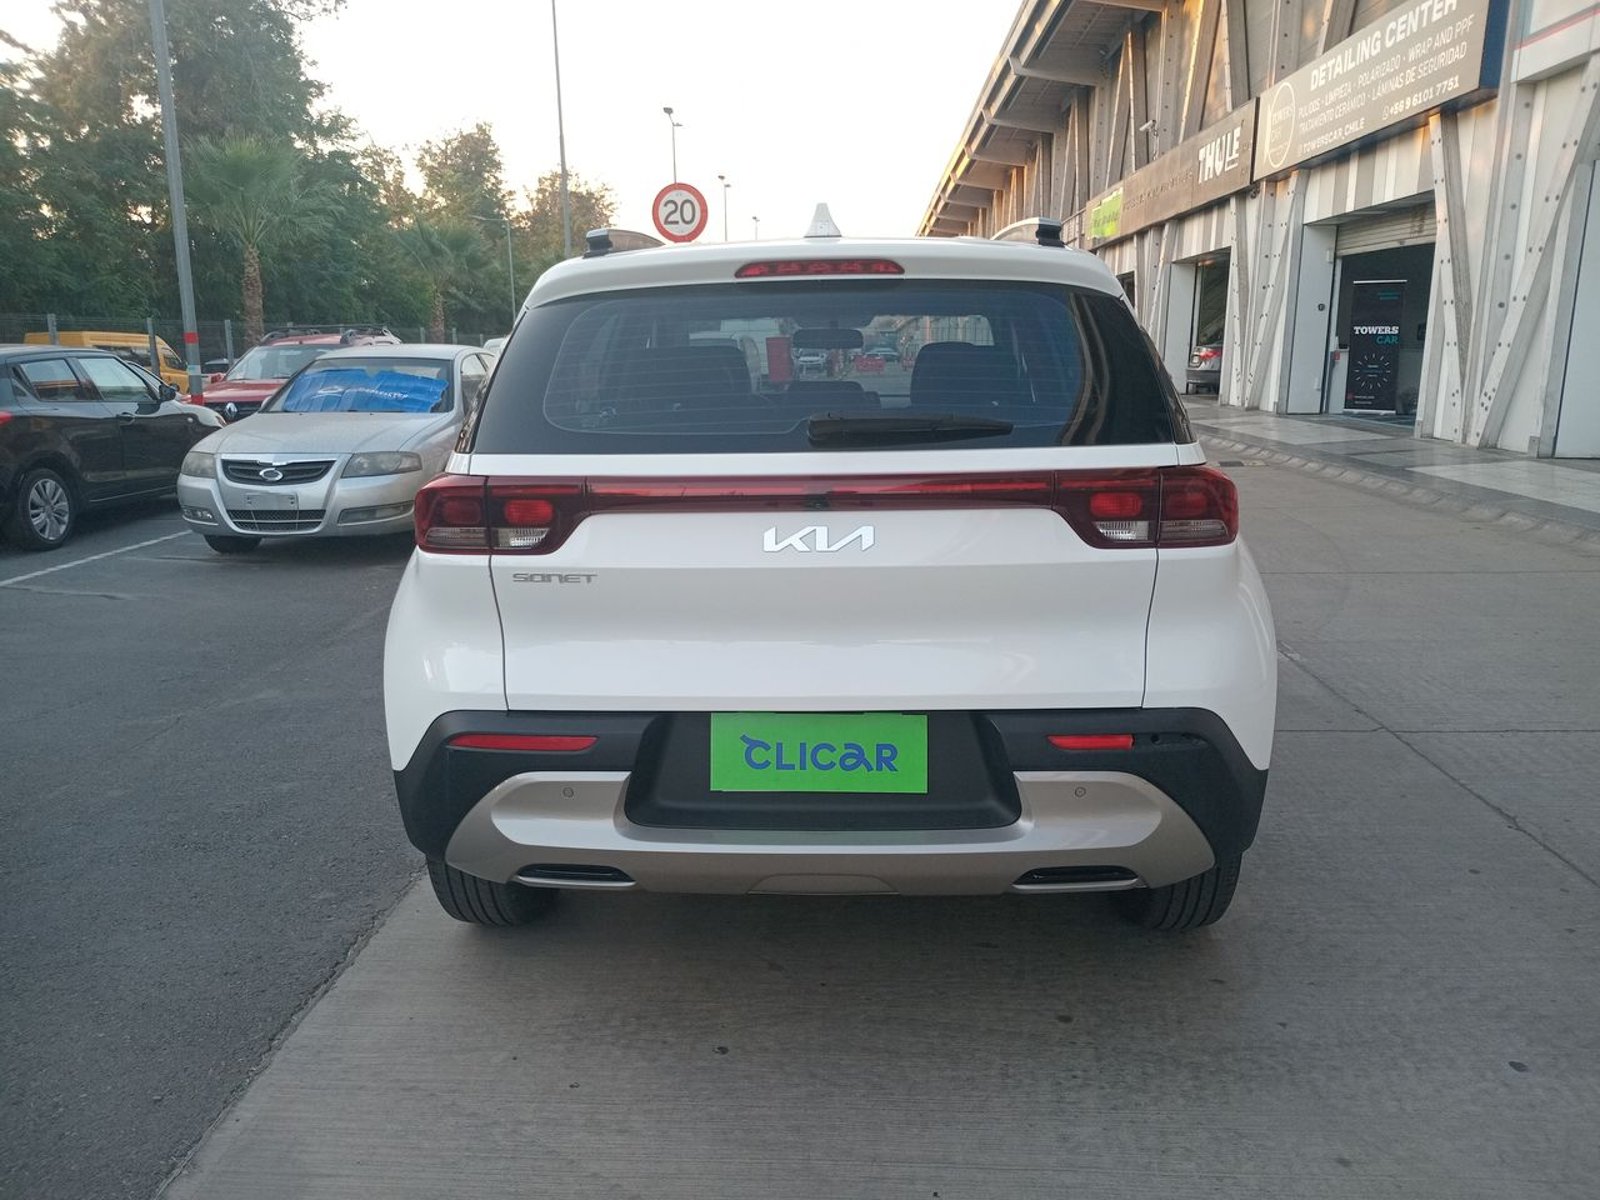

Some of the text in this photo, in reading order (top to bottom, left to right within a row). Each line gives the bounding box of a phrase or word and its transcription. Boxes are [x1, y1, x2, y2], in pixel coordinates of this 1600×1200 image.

[1310, 0, 1458, 91] DETAILING CENTER
[1358, 55, 1401, 87] POLARIZADO
[1409, 37, 1432, 61] WRAP
[1433, 24, 1453, 49] AND
[1454, 13, 1473, 39] PPF
[1404, 65, 1416, 85] DE
[1418, 41, 1467, 79] SEGURIDAD
[1412, 87, 1433, 106] 6101
[1435, 75, 1459, 95] 7751
[1198, 126, 1241, 184] THULE
[663, 199, 696, 225] 20
[1353, 325, 1400, 335] TOWERS
[1376, 335, 1399, 345] CAR
[763, 525, 876, 553] KIA
[512, 573, 598, 584] SONET
